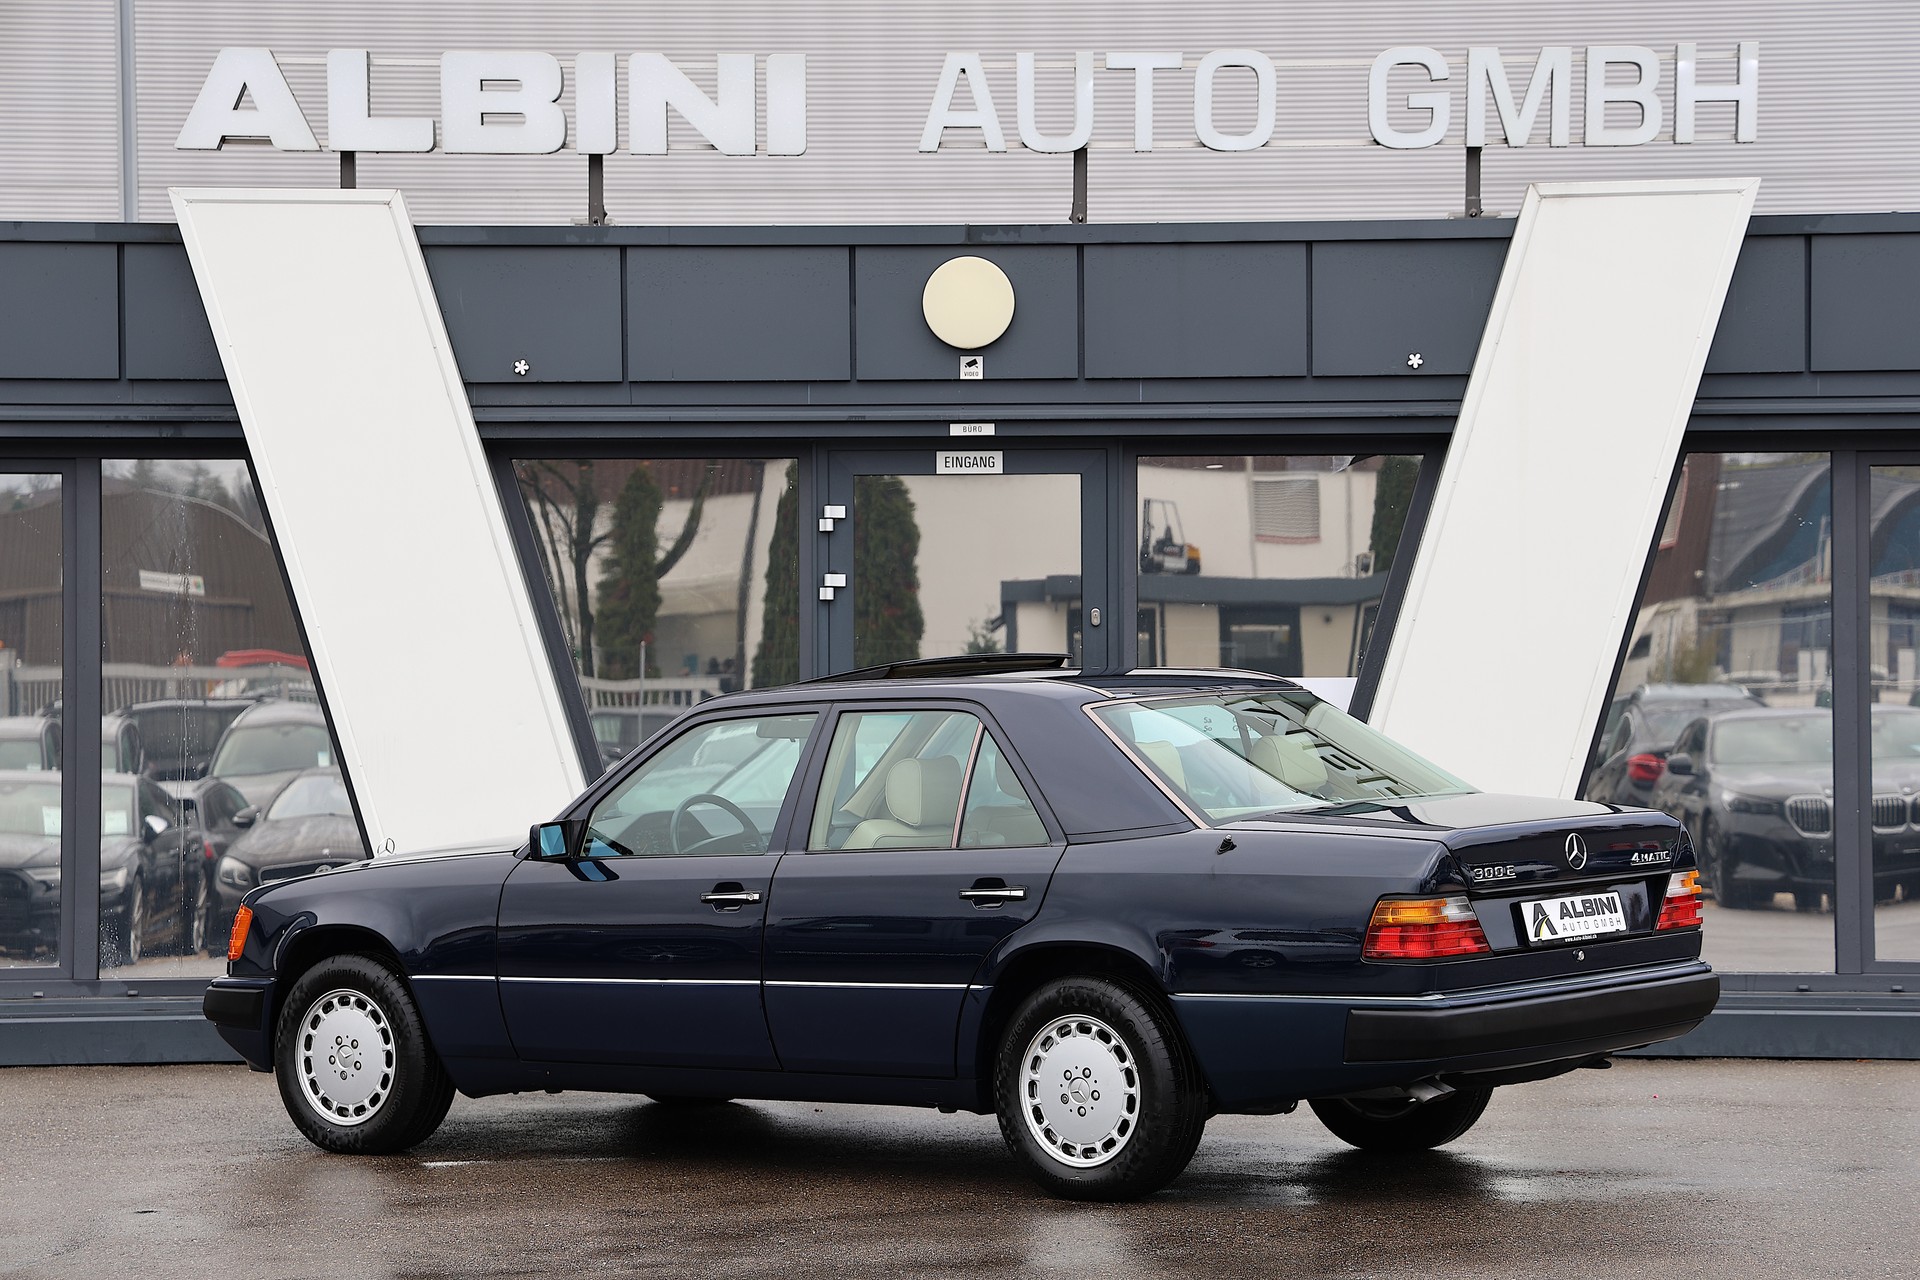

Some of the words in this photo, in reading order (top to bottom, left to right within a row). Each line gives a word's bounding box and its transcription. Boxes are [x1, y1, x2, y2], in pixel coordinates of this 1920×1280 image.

[174, 47, 807, 156] ALBINI
[917, 48, 1277, 153] AUTO
[1367, 41, 1759, 150] GMBH
[962, 425, 983, 433] BÜRO
[944, 456, 996, 468] EINGANG
[1559, 896, 1619, 920] ALBINI
[1562, 920, 1590, 933] AUTO
[1594, 917, 1622, 929] GMBH
